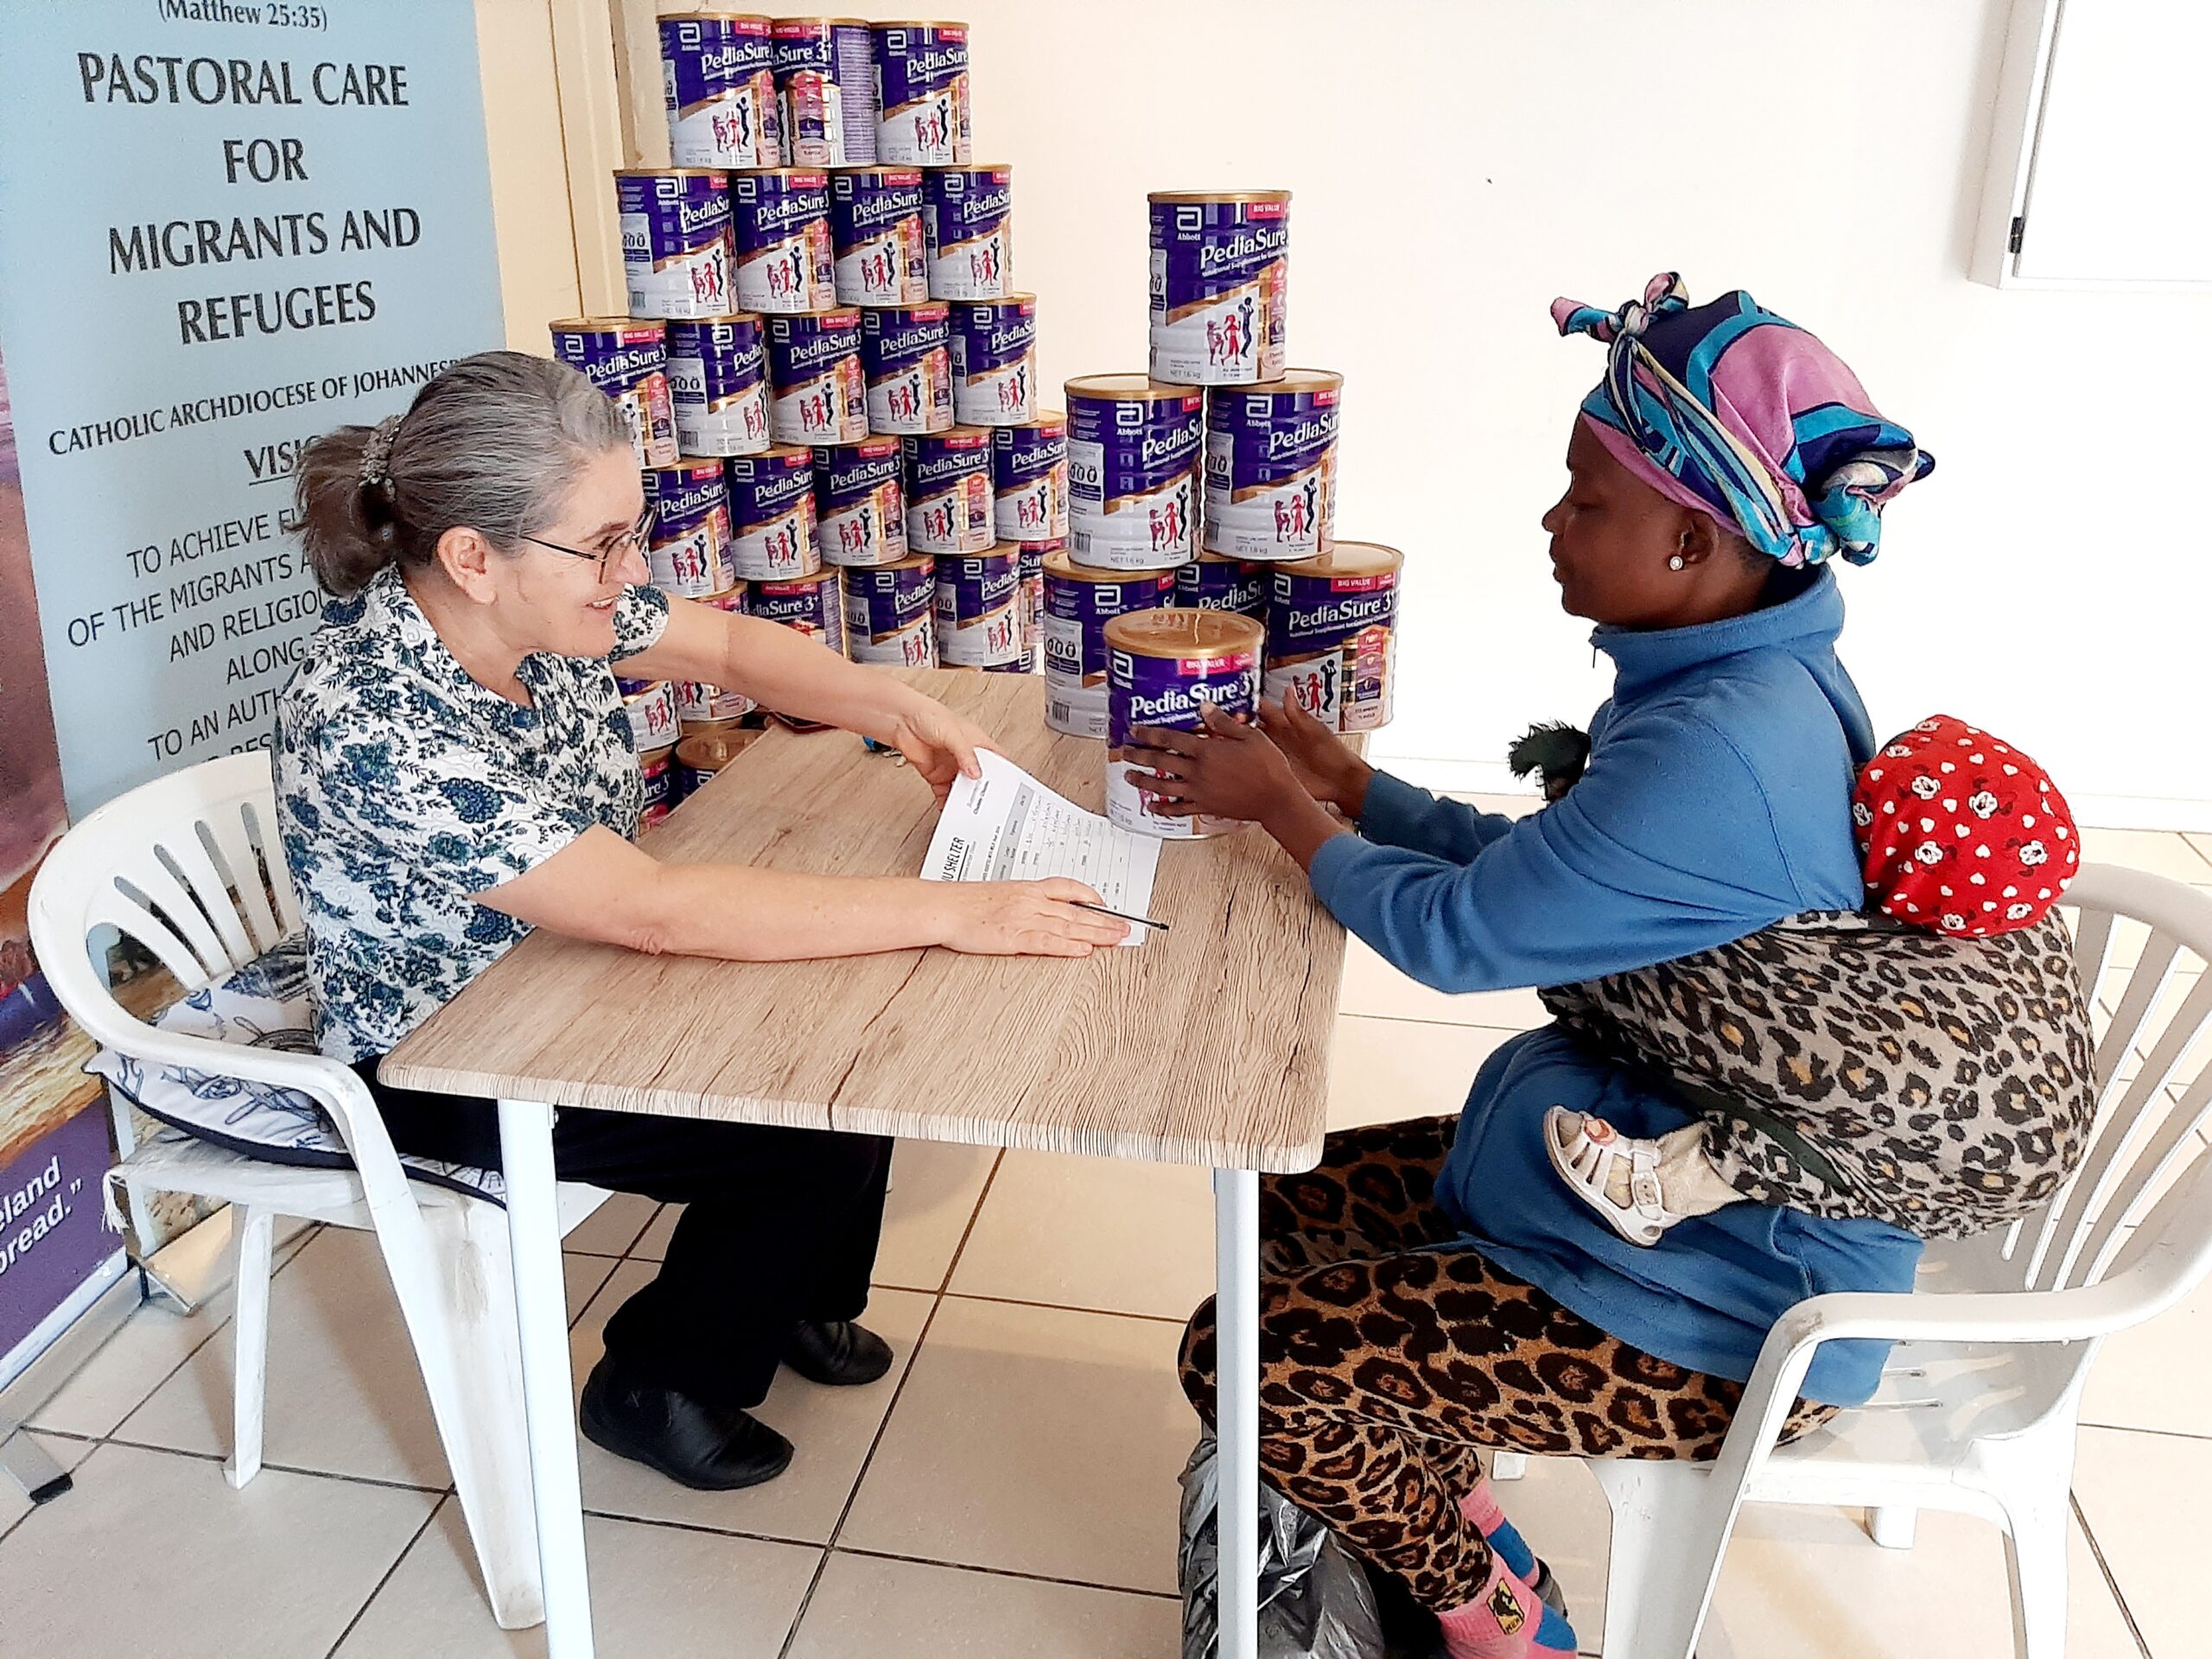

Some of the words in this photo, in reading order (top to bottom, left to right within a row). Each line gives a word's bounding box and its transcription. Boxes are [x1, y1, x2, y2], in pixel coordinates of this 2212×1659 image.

[158, 0, 263, 24] (Matthew
[266, 3, 328, 32] 25:35)
[78, 51, 302, 105] PASTORAL
[312, 61, 410, 106] CARE
[223, 138, 308, 183] FOR
[108, 212, 328, 275] MIGRANTS
[340, 208, 421, 253] AND
[1200, 227, 1287, 270] PediaSure
[178, 281, 376, 345] REFUGEES
[790, 334, 856, 364] PediaSure
[880, 327, 944, 355] PediaSure
[585, 350, 658, 383] PediaSure
[48, 409, 167, 455] CATHOLIC
[169, 381, 317, 429] ARCHDIOCESE
[321, 376, 349, 401] OF
[830, 462, 894, 490] PediaSure
[918, 453, 981, 478] PediaSure
[126, 544, 162, 578] TO
[169, 512, 271, 567] ACHIEVE
[67, 611, 105, 648] OF
[111, 592, 164, 632] THE
[169, 553, 293, 613] MIGRANTS
[1288, 598, 1382, 631] PediaSure
[169, 622, 215, 664] AND
[226, 636, 305, 685] ALONG
[1130, 681, 1239, 719] PediaSure
[148, 728, 182, 762] TO
[190, 709, 220, 747] AN
[944, 836, 965, 873] SHELTER
